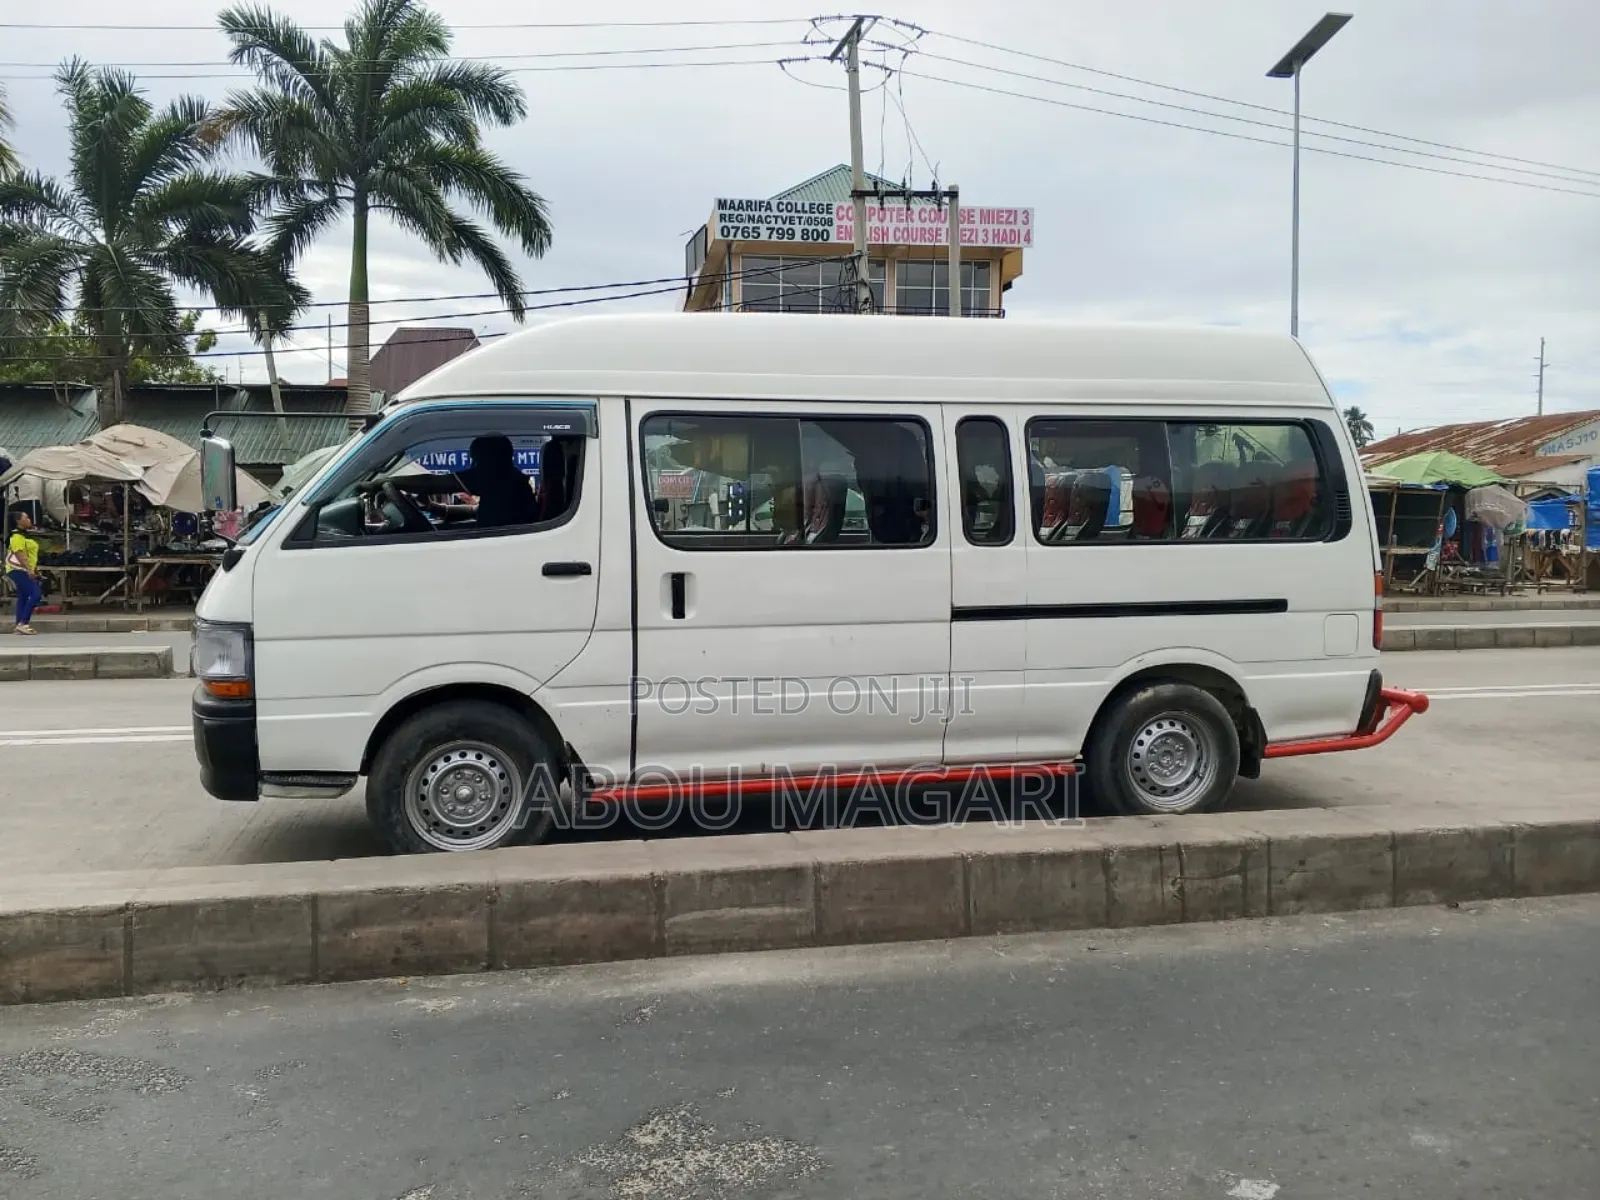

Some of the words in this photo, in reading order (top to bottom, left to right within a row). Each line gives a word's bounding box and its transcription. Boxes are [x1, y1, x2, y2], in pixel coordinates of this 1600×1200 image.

[717, 199, 773, 213] MAARIFA
[776, 201, 834, 215] COLLEGE
[835, 205, 914, 223] COPUTER
[918, 207, 976, 225] COUSE
[979, 208, 1018, 225] MIEZI
[1021, 209, 1030, 226] 3
[720, 225, 761, 240] 0765
[766, 226, 796, 241] 799
[800, 228, 831, 242] 800
[835, 224, 890, 242] ENISH
[893, 226, 942, 243] COURSE
[945, 227, 978, 244] EZI
[982, 228, 989, 244] 3
[992, 228, 1021, 244] HADI
[1023, 228, 1031, 245] 4
